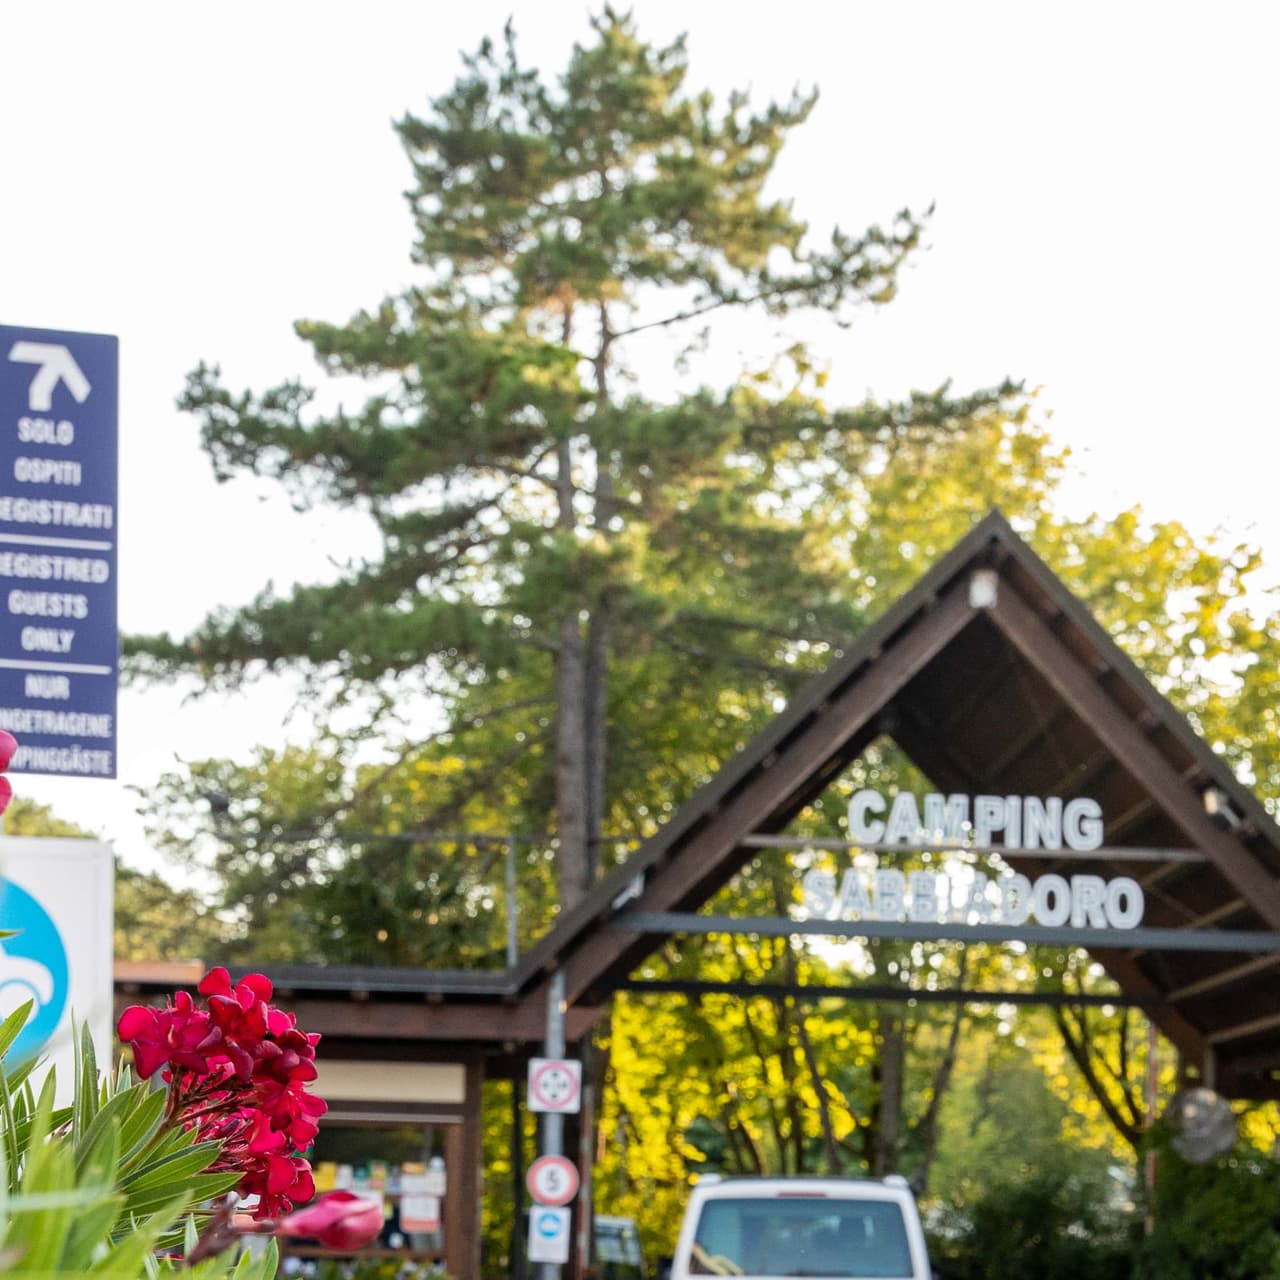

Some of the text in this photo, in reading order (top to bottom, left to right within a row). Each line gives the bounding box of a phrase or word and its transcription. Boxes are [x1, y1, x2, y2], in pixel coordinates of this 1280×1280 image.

[18, 417, 74, 446] SOLO
[14, 457, 82, 486] OSPITI
[7, 589, 88, 619] GUESTS
[21, 626, 75, 653] ONLY
[24, 674, 70, 699] NUR
[847, 788, 1105, 851] CAMPING
[547, 1168, 560, 1193] 5
